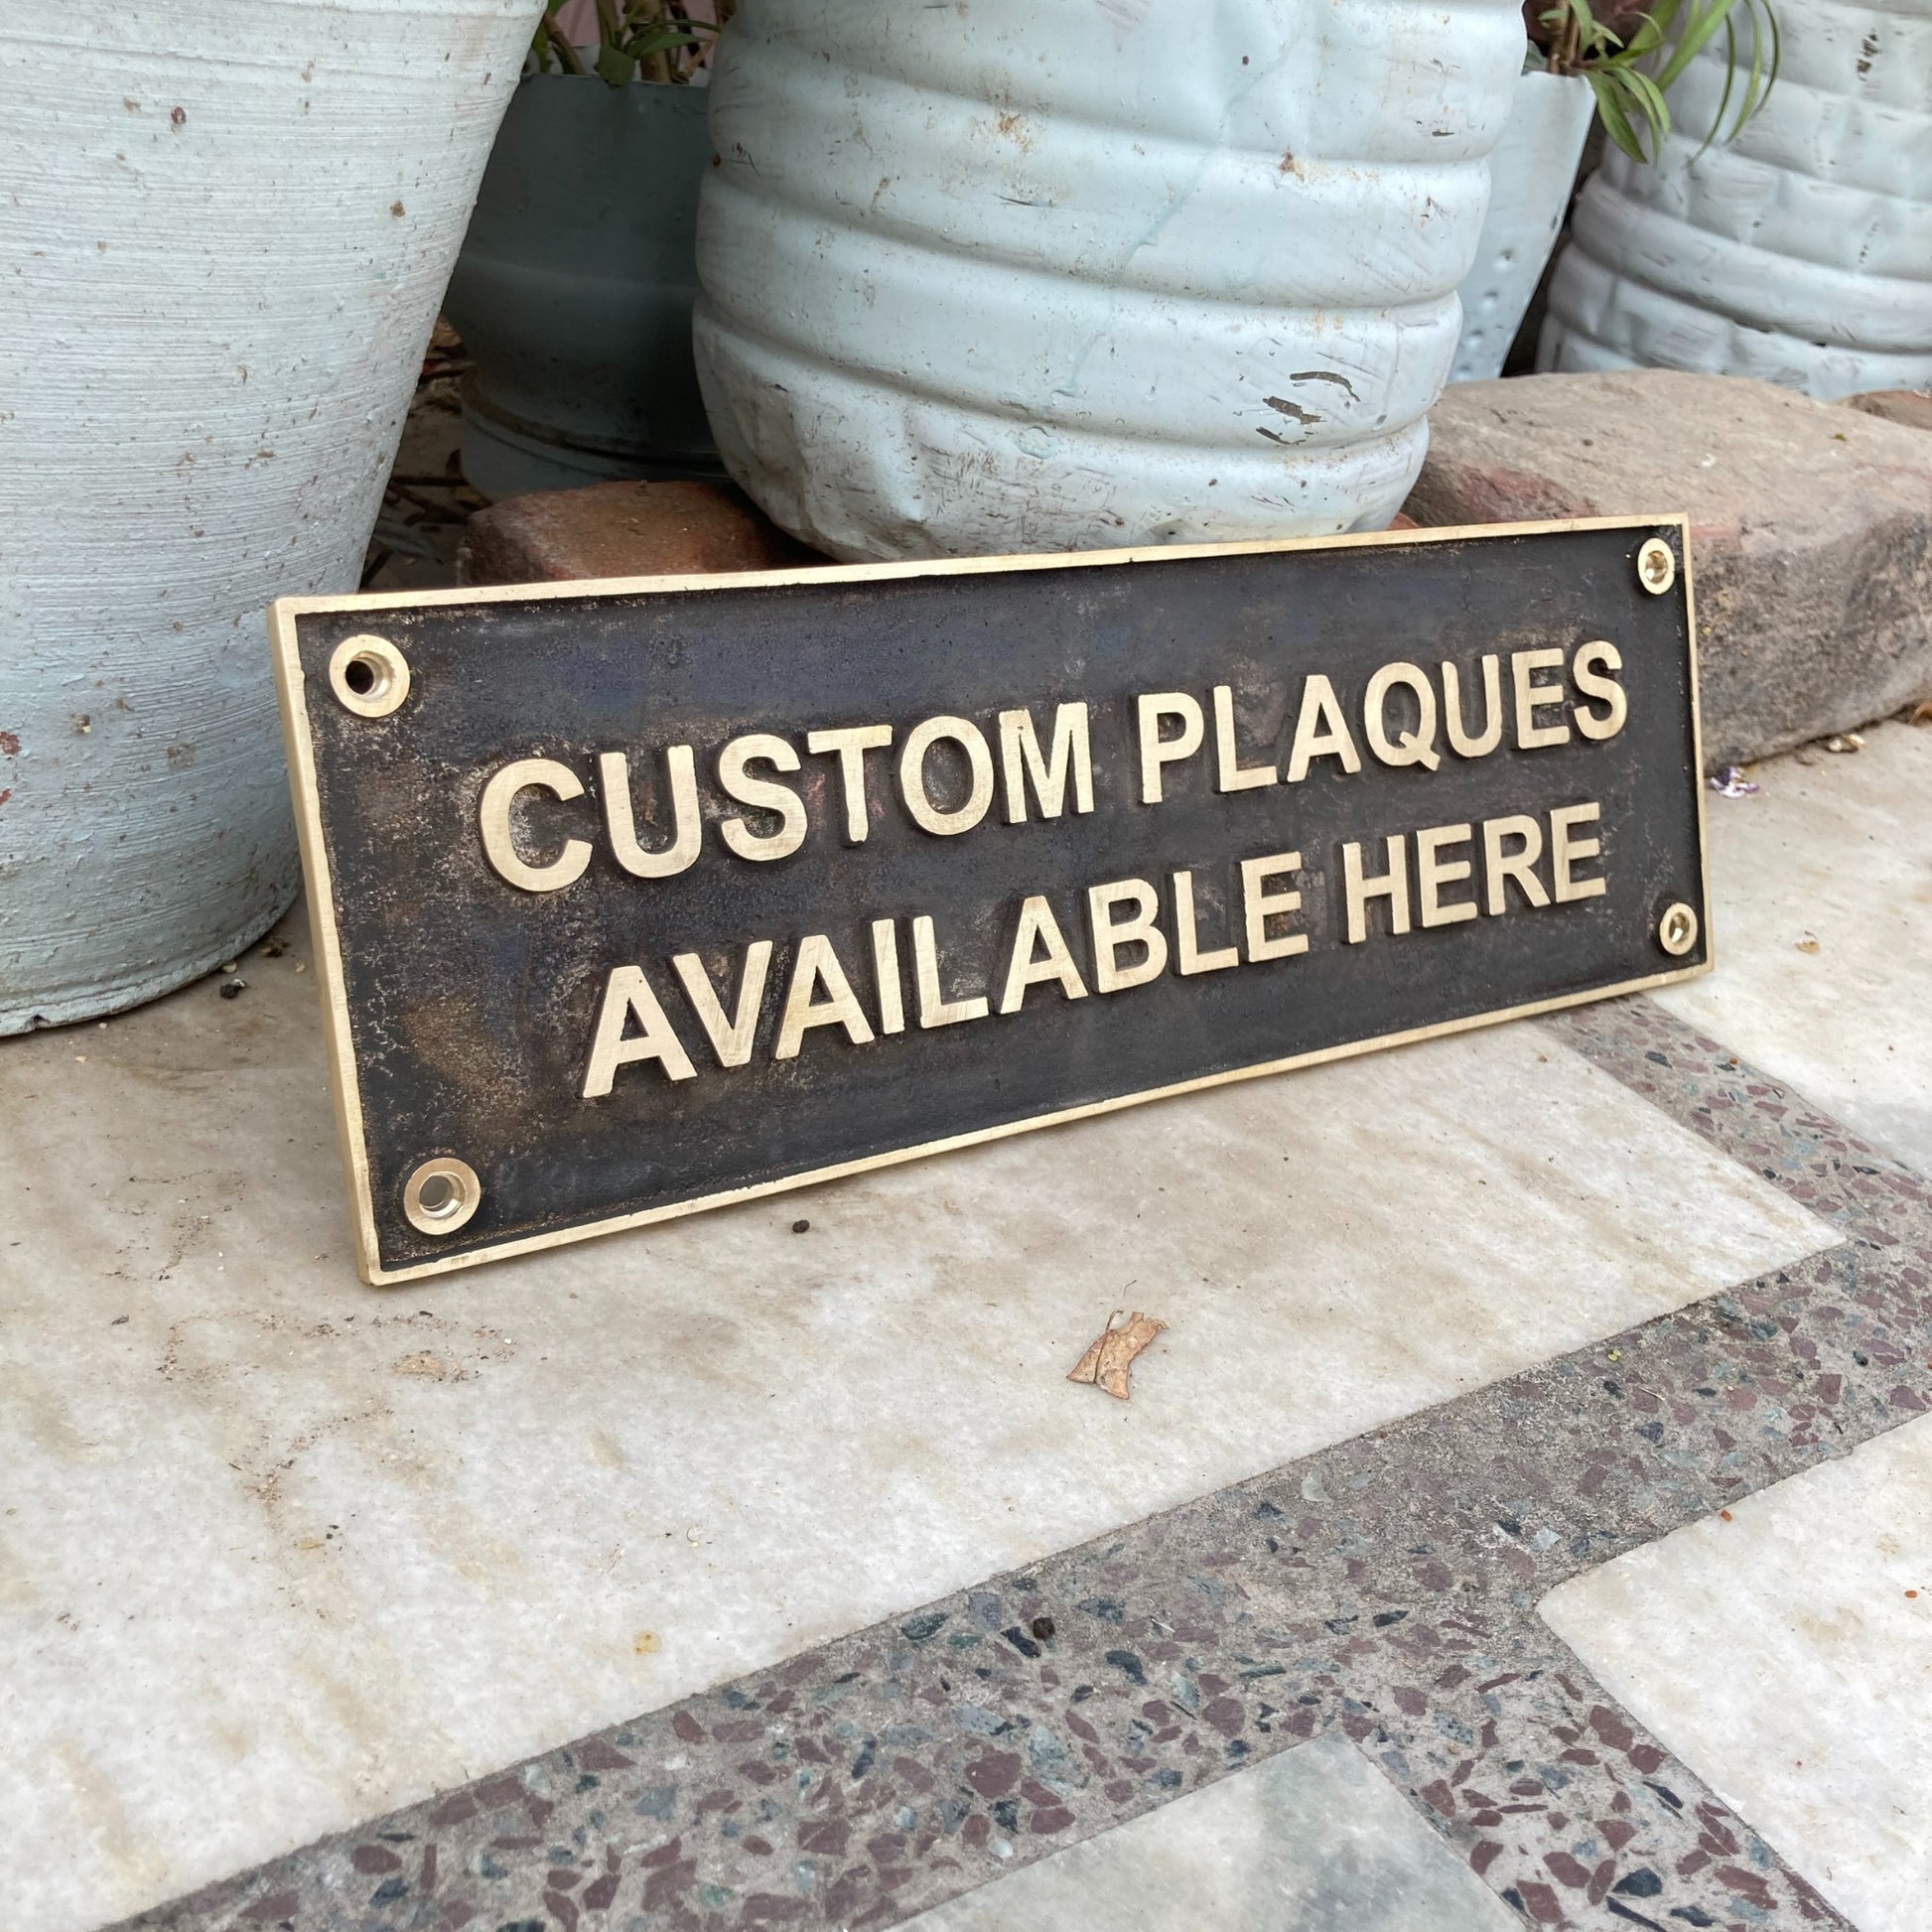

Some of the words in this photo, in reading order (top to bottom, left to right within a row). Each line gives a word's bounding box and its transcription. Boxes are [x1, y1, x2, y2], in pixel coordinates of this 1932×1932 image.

[479, 702, 1095, 893] CUSTOM
[1138, 640, 1628, 804] PLAQUES
[583, 851, 1309, 1098] AVAILABLE
[1342, 802, 1607, 943] HERE
